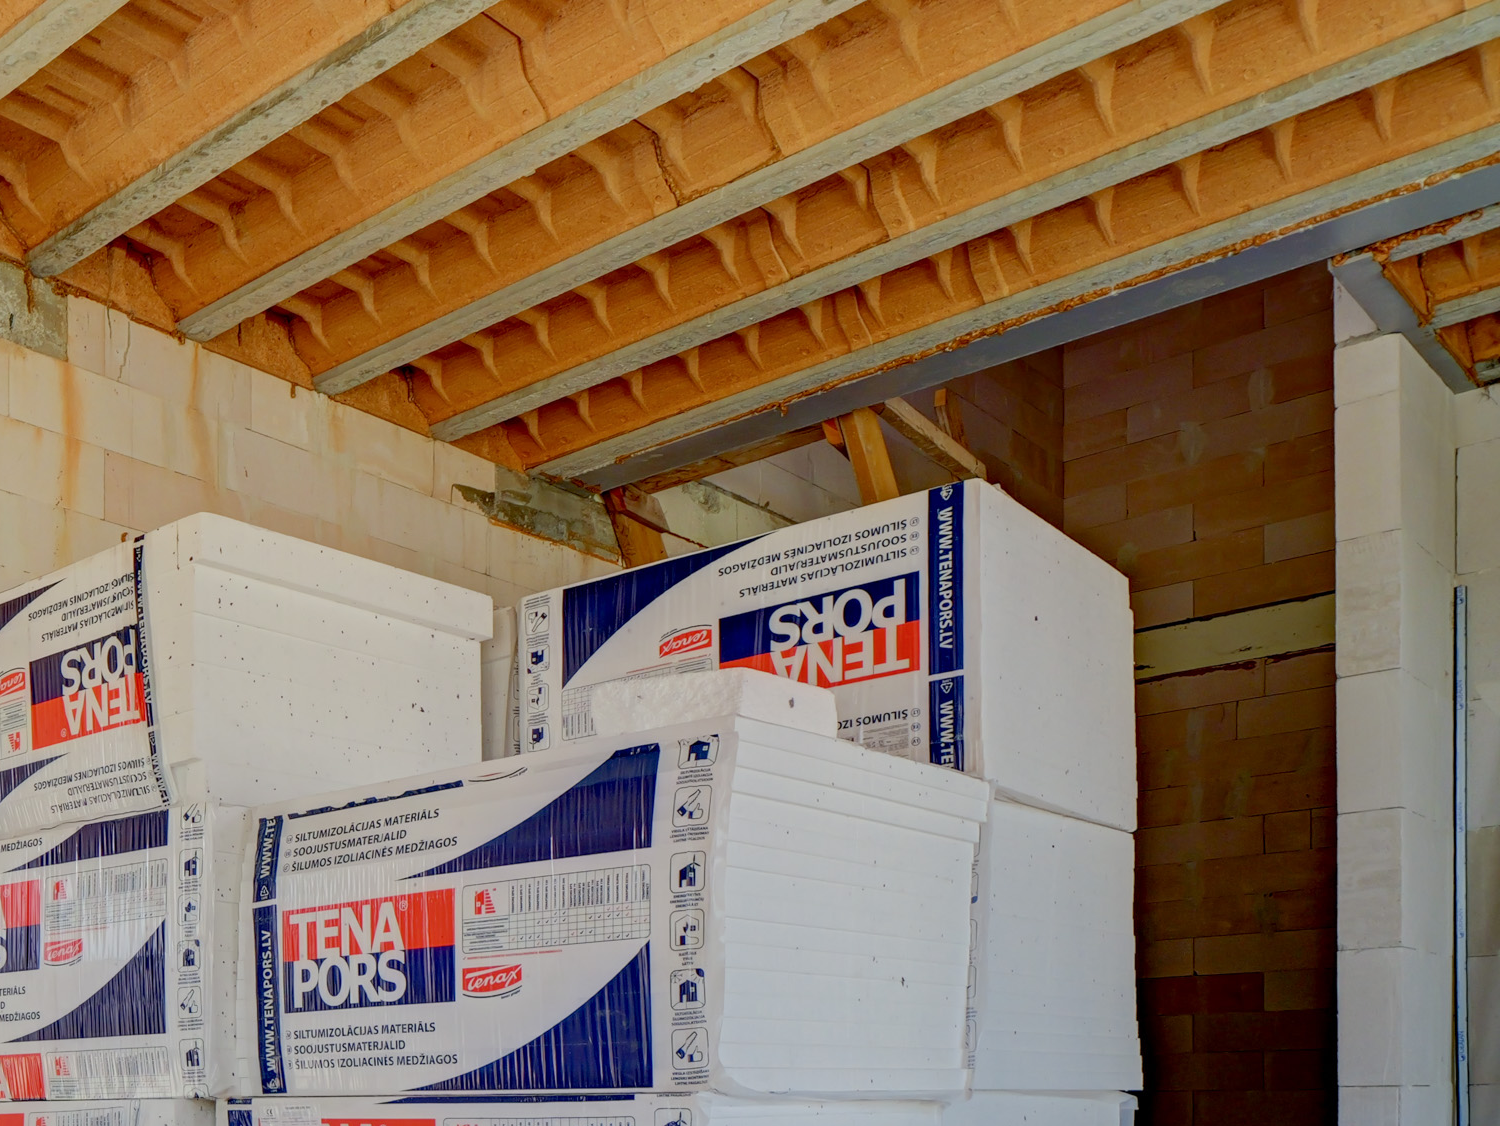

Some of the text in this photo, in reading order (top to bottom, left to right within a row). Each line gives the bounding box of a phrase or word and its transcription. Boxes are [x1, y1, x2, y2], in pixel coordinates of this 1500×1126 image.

[855, 518, 907, 540] ŠILUMOS
[771, 533, 906, 576] SOOJUSTUSMATERJALID
[784, 532, 851, 560] IZOLIACINĖS
[718, 550, 781, 576] MEDŽIAGOS
[739, 548, 906, 598] SILTUMIZOLĀCIJAS MATERIĀLS
[937, 506, 954, 649] WWW.TENAPORS.LV
[769, 578, 906, 651] PORS
[61, 629, 136, 695] PORS
[856, 709, 908, 725] ŠILUMOS
[294, 809, 440, 843] SILTUMIZOLĀCIJAS MATERIĀLS
[0, 838, 42, 853] MEDŽIAGOS
[291, 836, 458, 872] ŠILUMOS IZOLIACINĖS MEDŽIAGOS
[293, 830, 406, 857] SOOJUSTUSMATERJALID
[293, 950, 407, 1008] PORS
[261, 930, 278, 1072] WWW.TENAPORS.LV
[0, 1011, 40, 1022] MEDŽIAGOS
[294, 1022, 436, 1040] SILTUMIZOLĀCIJAS MATERIĀLS
[294, 1040, 406, 1055] SOOJUSTUSMATERJALID
[397, 1053, 458, 1066] MEDŽIAGOS
